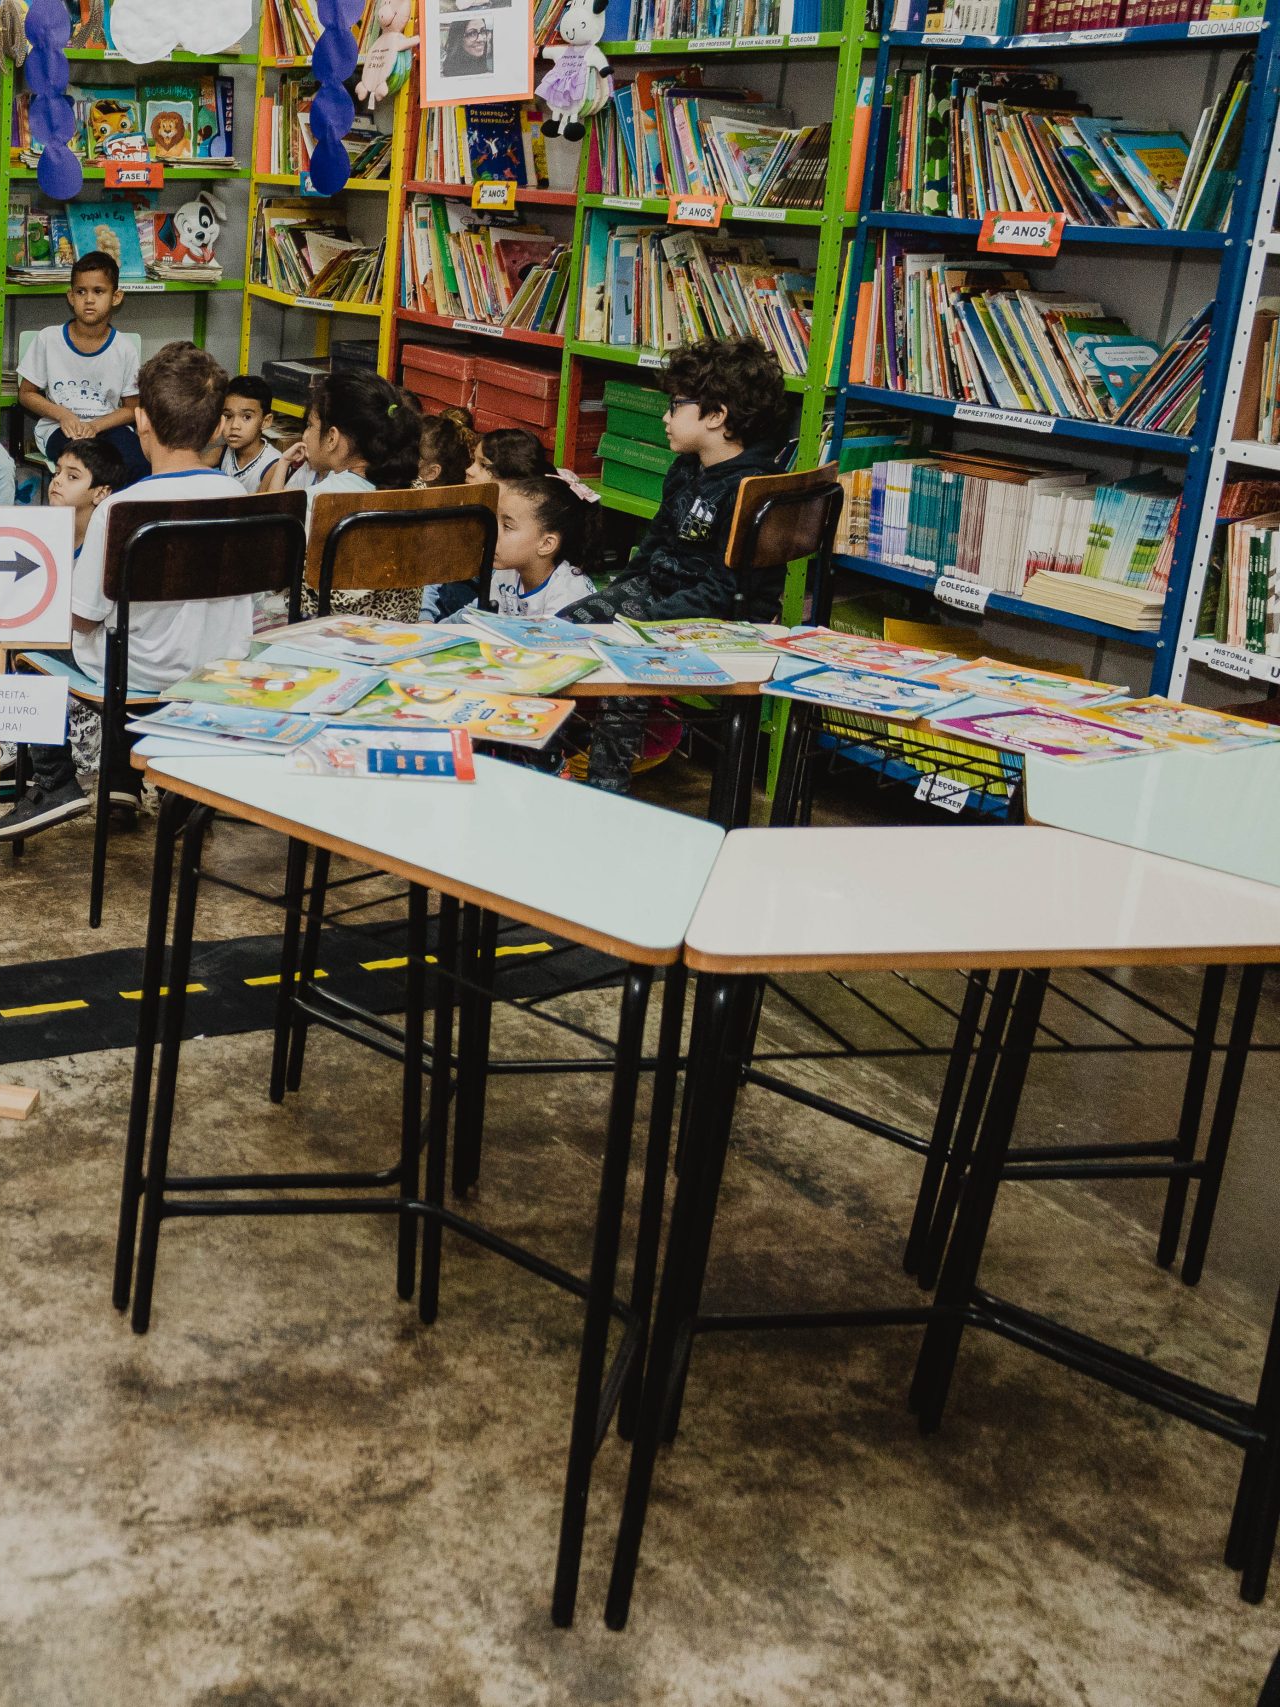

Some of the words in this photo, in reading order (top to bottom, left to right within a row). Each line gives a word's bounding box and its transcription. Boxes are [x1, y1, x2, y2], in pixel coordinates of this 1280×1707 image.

[488, 189, 506, 198] ANOS
[688, 207, 713, 218] ANOS
[1011, 226, 1047, 237] ANOS
[957, 408, 1004, 421] EMPRÉSTIMOS
[1004, 415, 1023, 423] PARA
[1023, 418, 1053, 428] ALUNOS
[940, 580, 980, 596] COLEÇÕES
[937, 593, 953, 603] NÃO
[954, 598, 980, 611] MEXER
[1213, 647, 1247, 662] HISTÓRIA
[1210, 658, 1250, 676] GEOGRAFIA
[8, 705, 40, 717] LIVRO.
